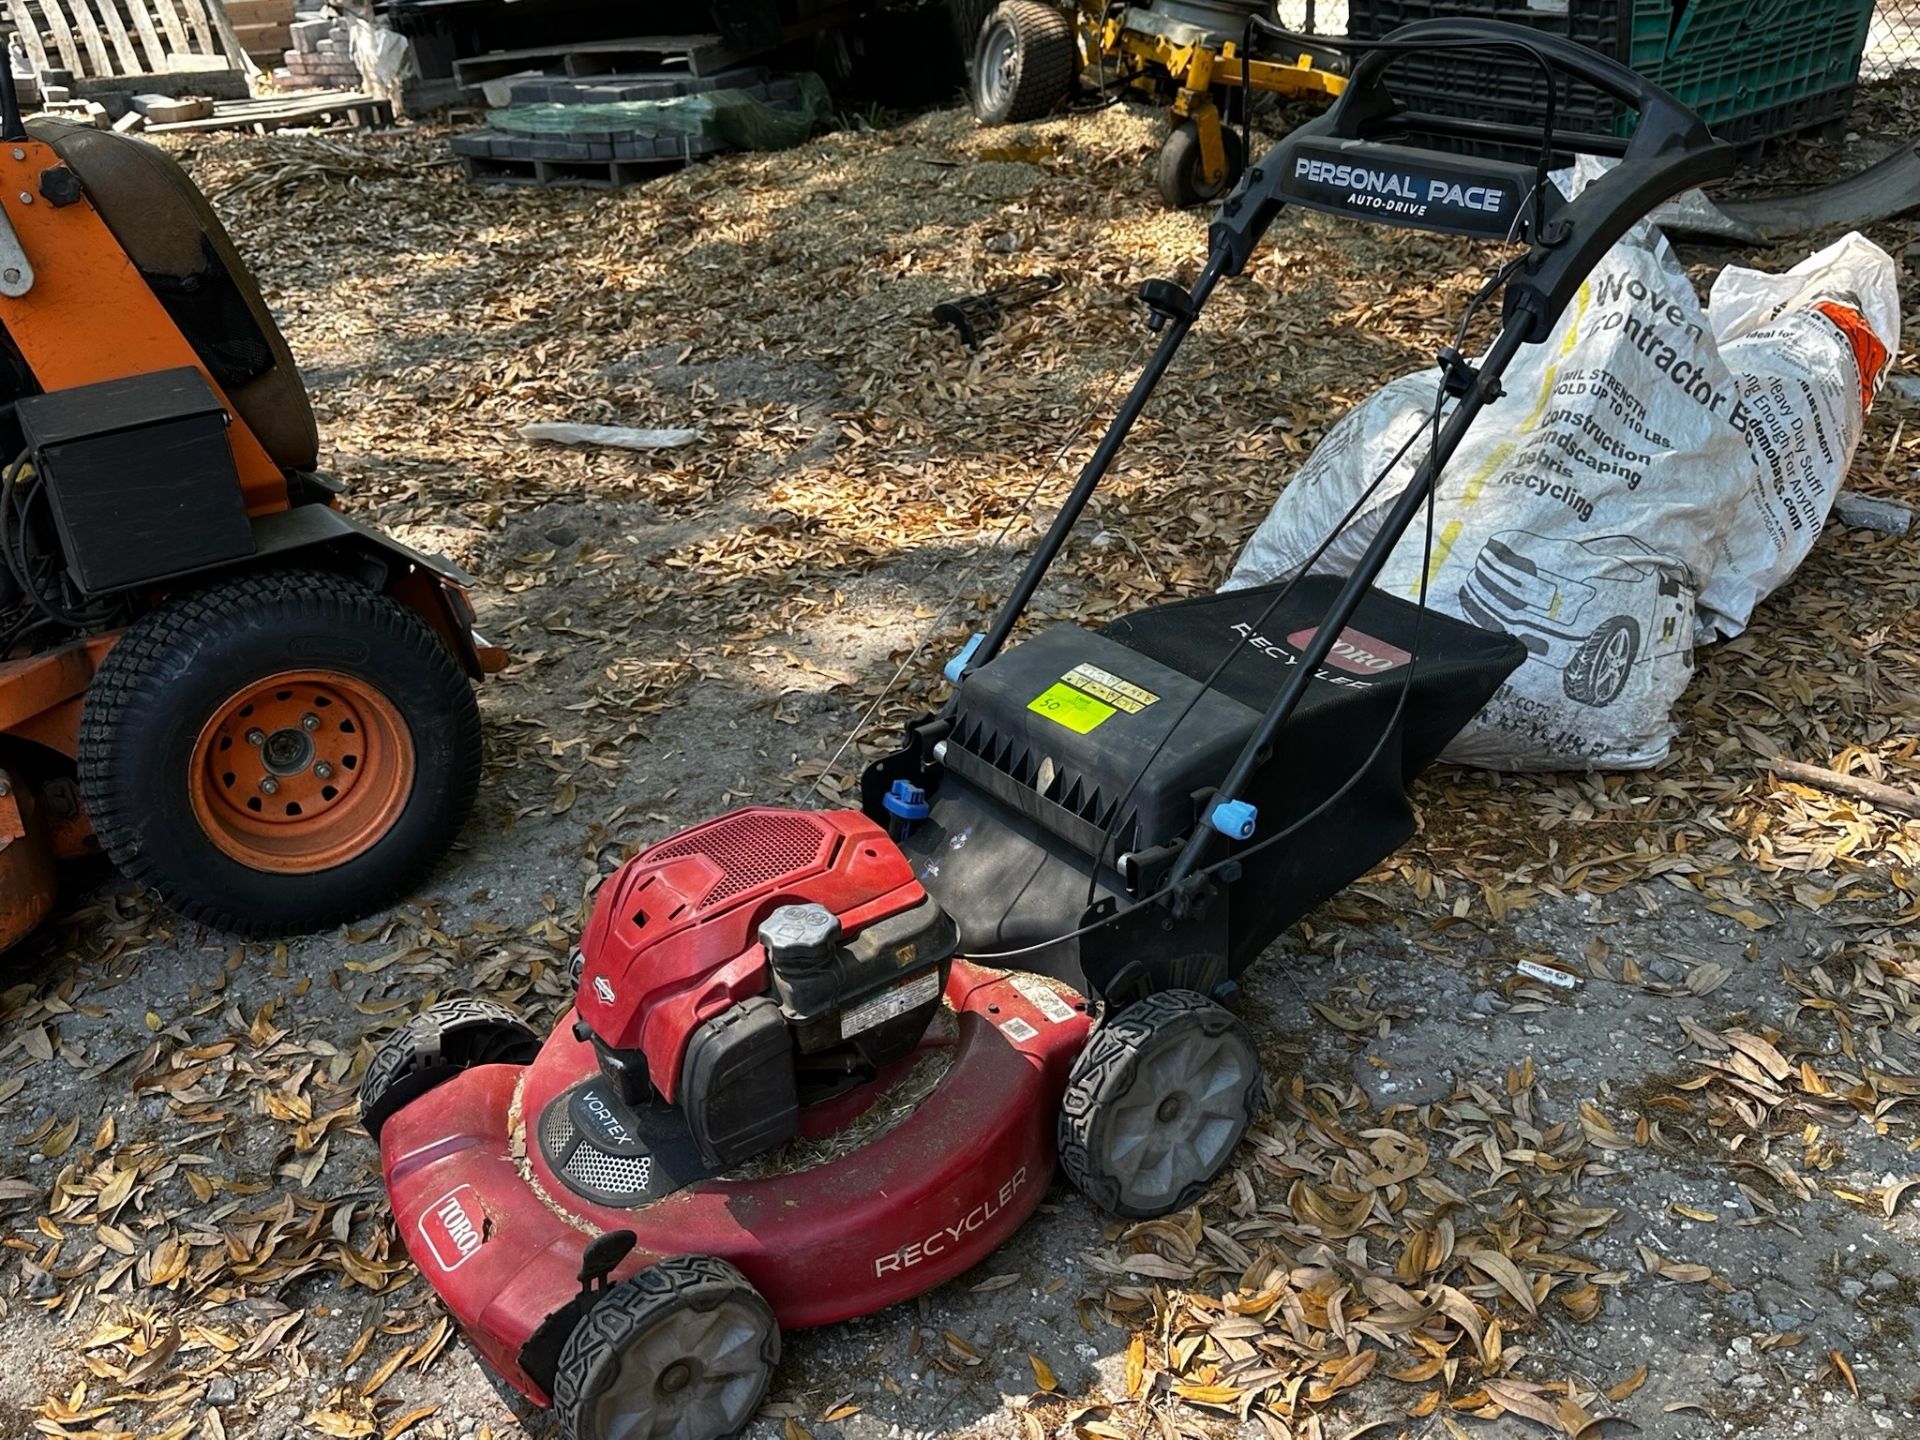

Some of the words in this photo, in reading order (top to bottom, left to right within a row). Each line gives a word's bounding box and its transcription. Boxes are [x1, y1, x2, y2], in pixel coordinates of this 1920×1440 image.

[1294, 157, 1418, 199] PERSONAL
[1427, 179, 1504, 213] PACE
[1347, 193, 1428, 216] AUTO-DRIVE
[1596, 271, 1704, 345] Woven
[1589, 368, 1648, 421] STRENGTH
[1590, 383, 1608, 400] UP
[1608, 396, 1623, 417] TO
[1623, 412, 1643, 435] 110
[1753, 394, 1792, 450] Enough
[1784, 451, 1797, 477] For
[1790, 417, 1807, 454] Duty
[1813, 413, 1834, 465] CAPACITY
[1499, 471, 1595, 523] Recycling
[1330, 637, 1394, 670] ORO
[582, 1090, 633, 1145] VORTEX
[436, 1196, 479, 1252] TORO
[874, 1164, 1028, 1279] RECYCLER
